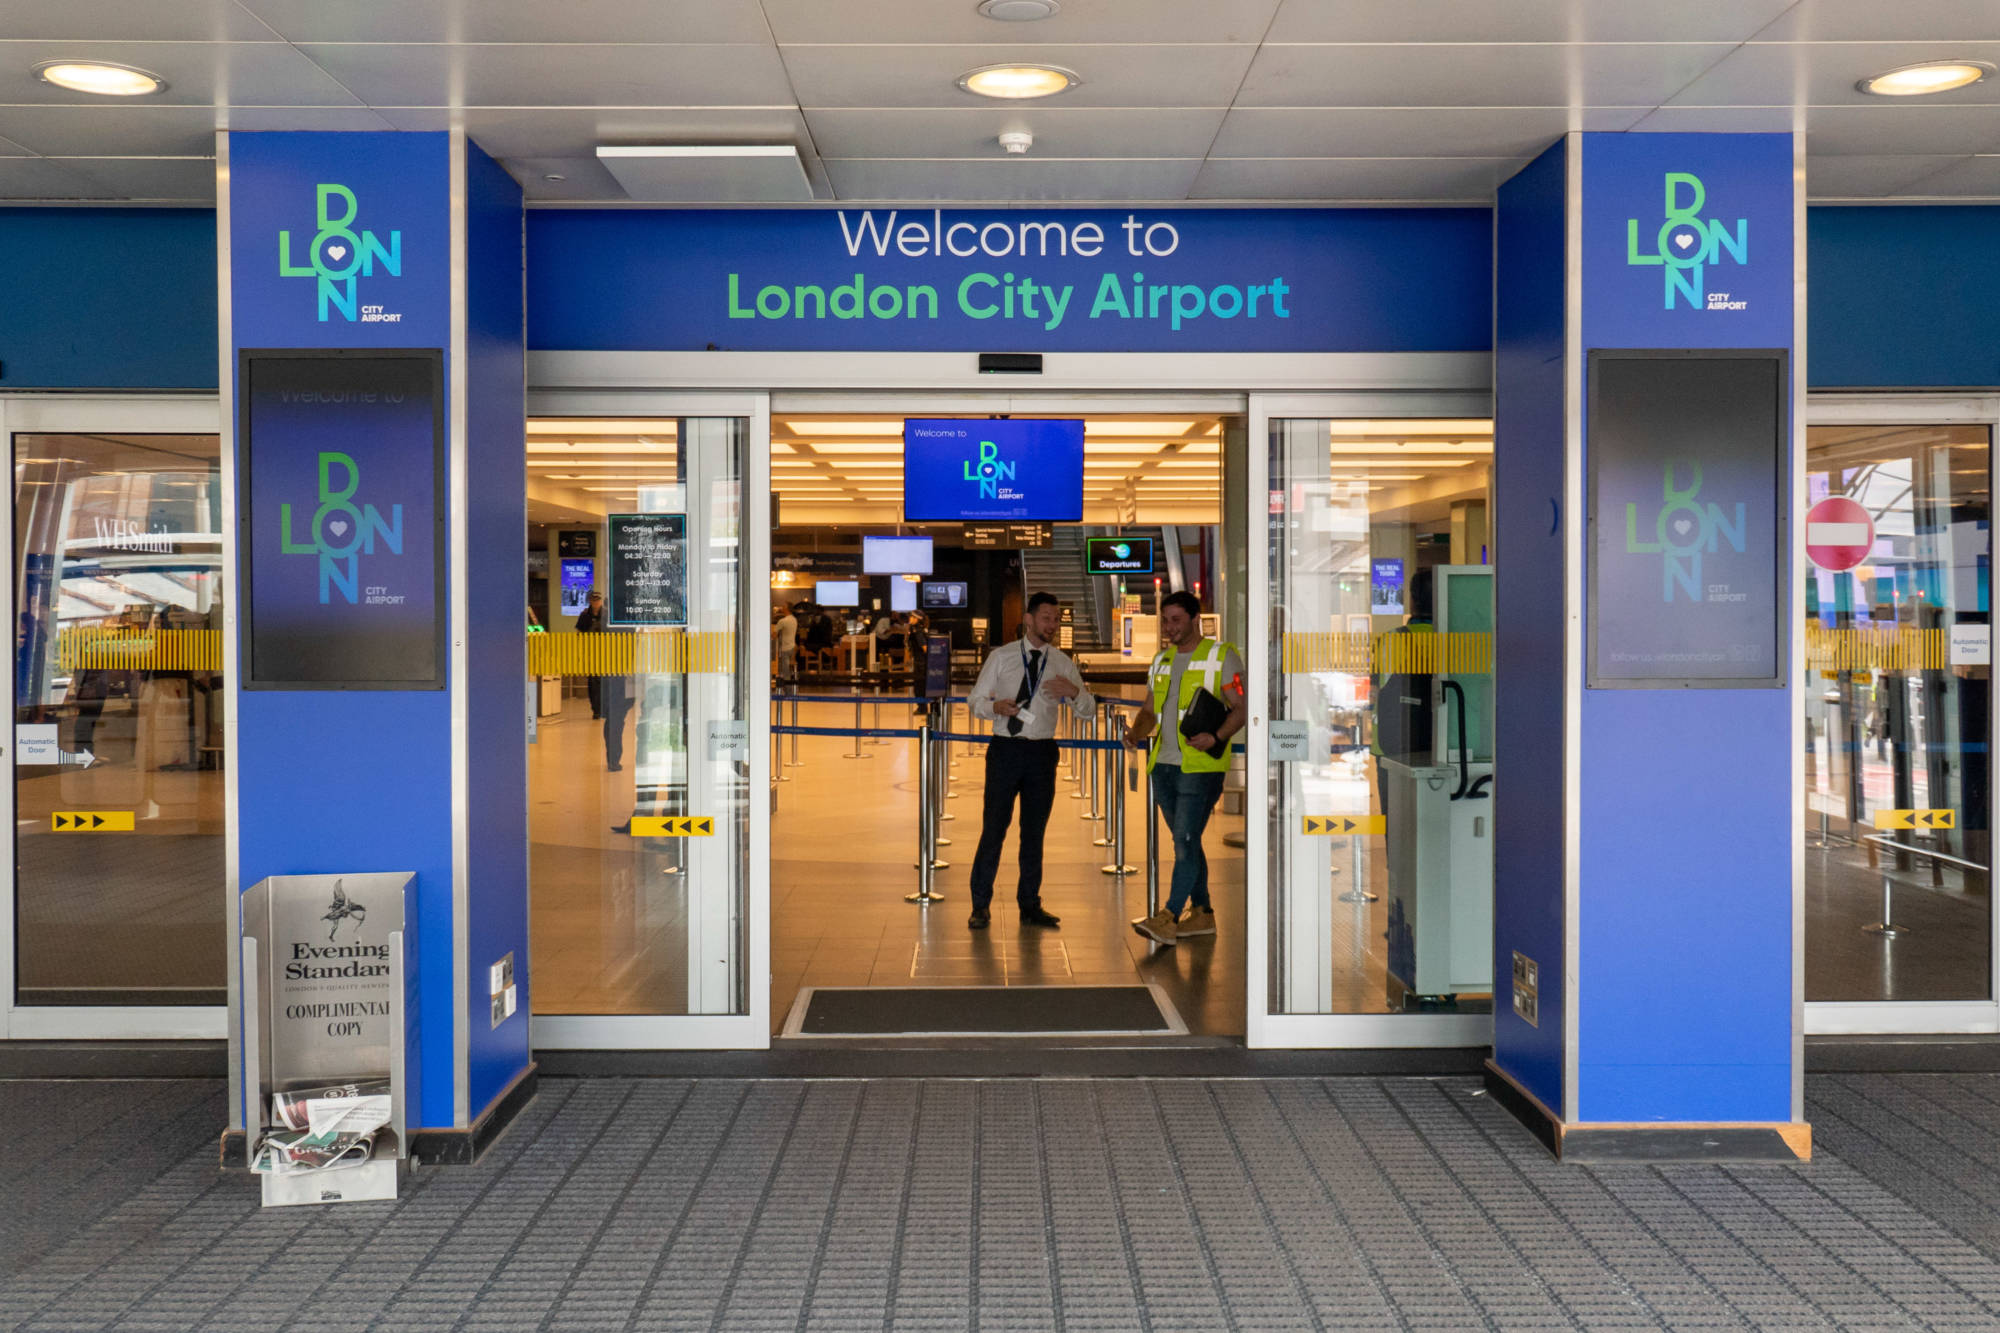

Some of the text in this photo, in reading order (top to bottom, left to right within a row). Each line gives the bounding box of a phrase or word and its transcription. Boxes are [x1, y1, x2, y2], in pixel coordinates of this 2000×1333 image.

[837, 209, 1179, 257] Welcome to
[728, 272, 1290, 331] London City Airport
[1707, 293, 1730, 301] CITY
[361, 305, 384, 313] CITY
[1707, 302, 1748, 310] AIRPORT
[361, 314, 402, 322] AIRPORT
[915, 429, 967, 438] Welcome to
[1099, 560, 1142, 569] Departures
[633, 570, 663, 578] Saturday
[365, 587, 387, 595] CITY
[1708, 584, 1729, 593] CITY
[365, 596, 405, 605] AIRPORT
[1708, 594, 1747, 602] AIRPORT
[291, 940, 390, 961] Evening
[283, 961, 390, 981] Standar
[327, 1021, 362, 1037] COPY
